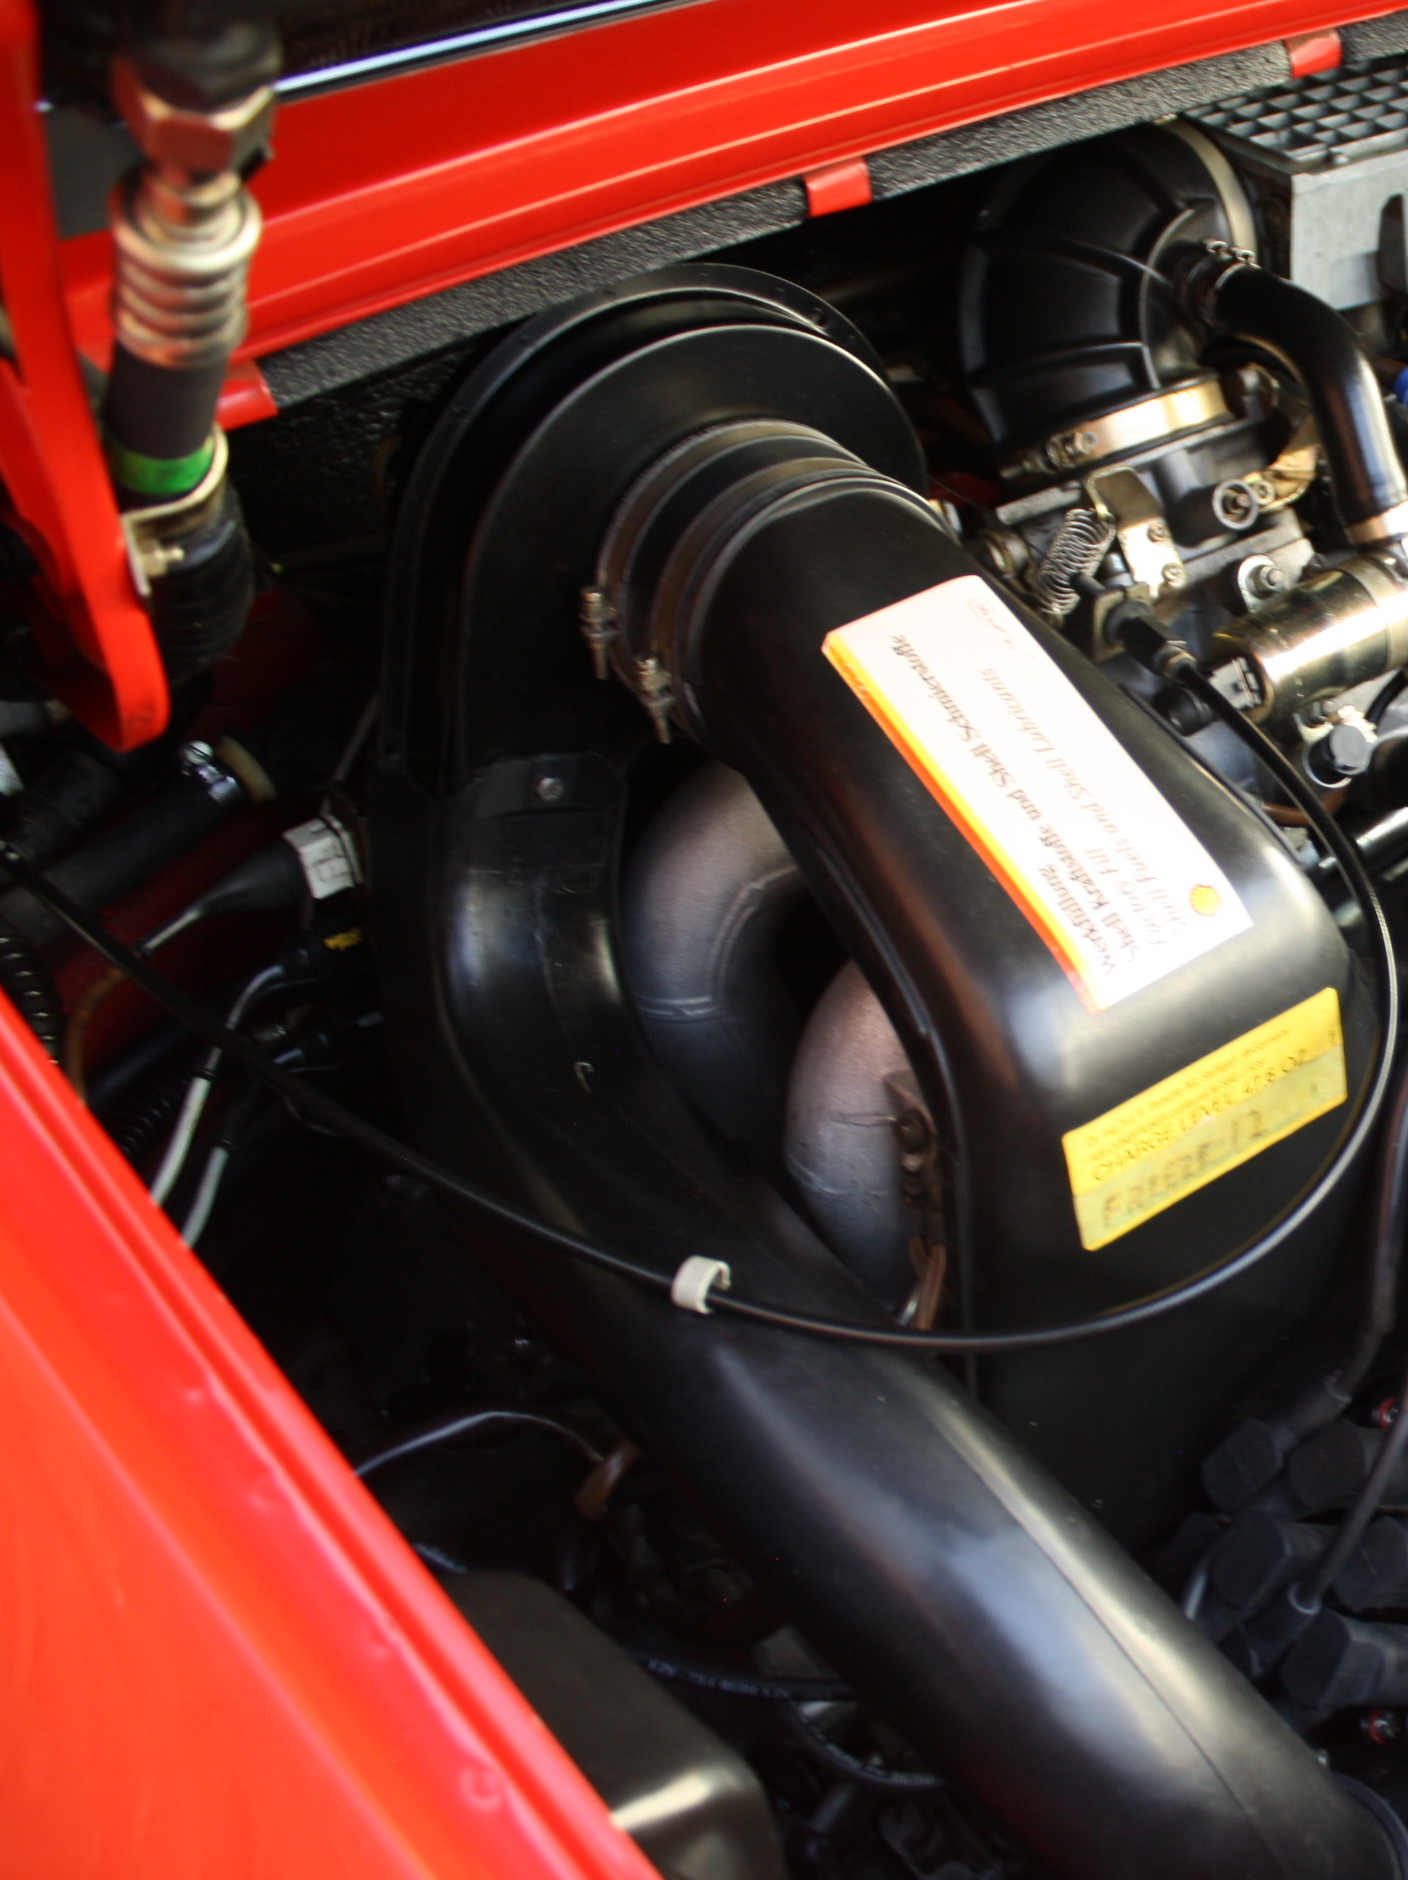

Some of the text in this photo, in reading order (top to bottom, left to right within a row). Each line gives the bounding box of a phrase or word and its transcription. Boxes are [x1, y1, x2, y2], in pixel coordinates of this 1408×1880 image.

[979, 667, 1055, 754] Lubricants
[890, 633, 1140, 963] Shell Kraftstoffe und Shell Schmierstoffe
[1043, 757, 1092, 800] Shell
[1080, 802, 1121, 834] and
[1083, 848, 1120, 876] Fill
[1115, 836, 1157, 883] Fuels
[1038, 863, 1117, 976] Werkfüllung
[1146, 887, 1187, 935] hell
